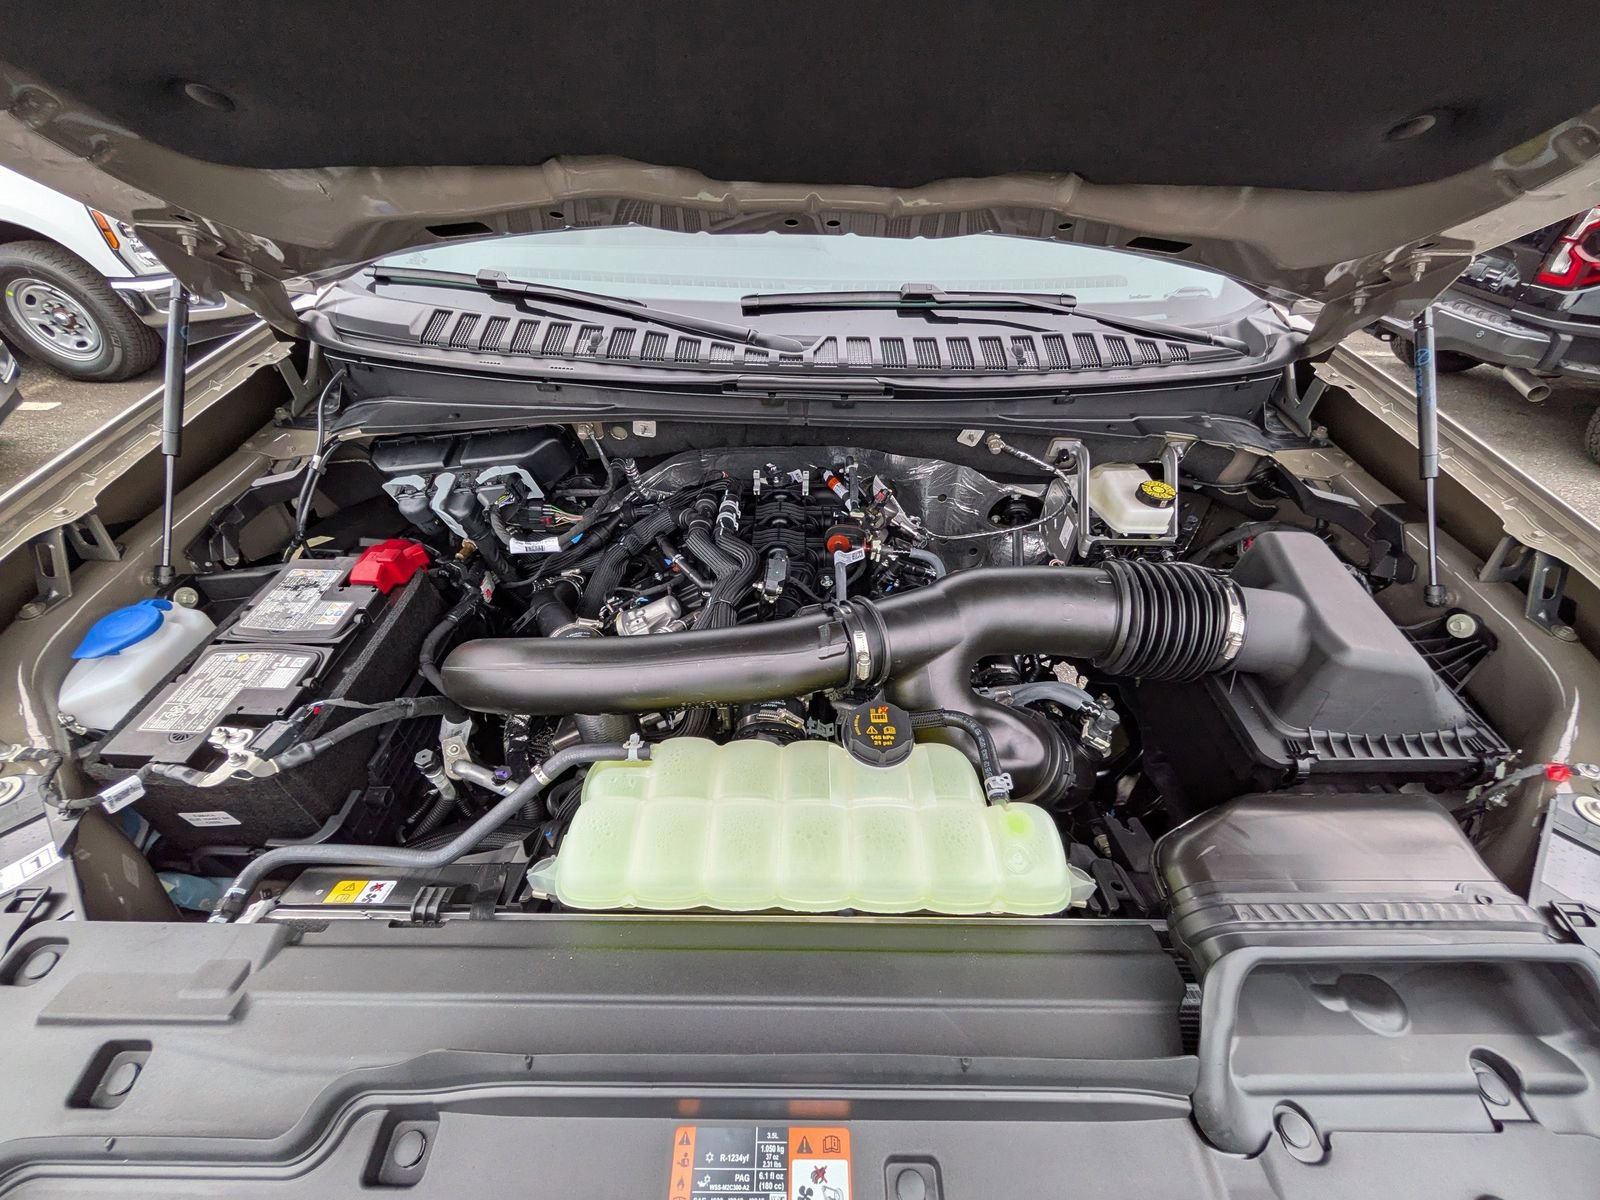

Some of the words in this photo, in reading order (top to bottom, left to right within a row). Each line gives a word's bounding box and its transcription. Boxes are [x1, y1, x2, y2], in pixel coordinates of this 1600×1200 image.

[760, 1144, 776, 1153] 1.050
[777, 1144, 785, 1154] kg
[719, 1153, 750, 1164] R-1234yf
[762, 1160, 773, 1168] 2.31
[773, 1160, 782, 1168] lbs
[734, 1173, 750, 1182] PAG
[758, 1171, 768, 1180] 6.1
[769, 1171, 775, 1180] fl
[775, 1172, 784, 1180] oz
[758, 1181, 773, 1191] (180
[773, 1181, 785, 1191] cc)
